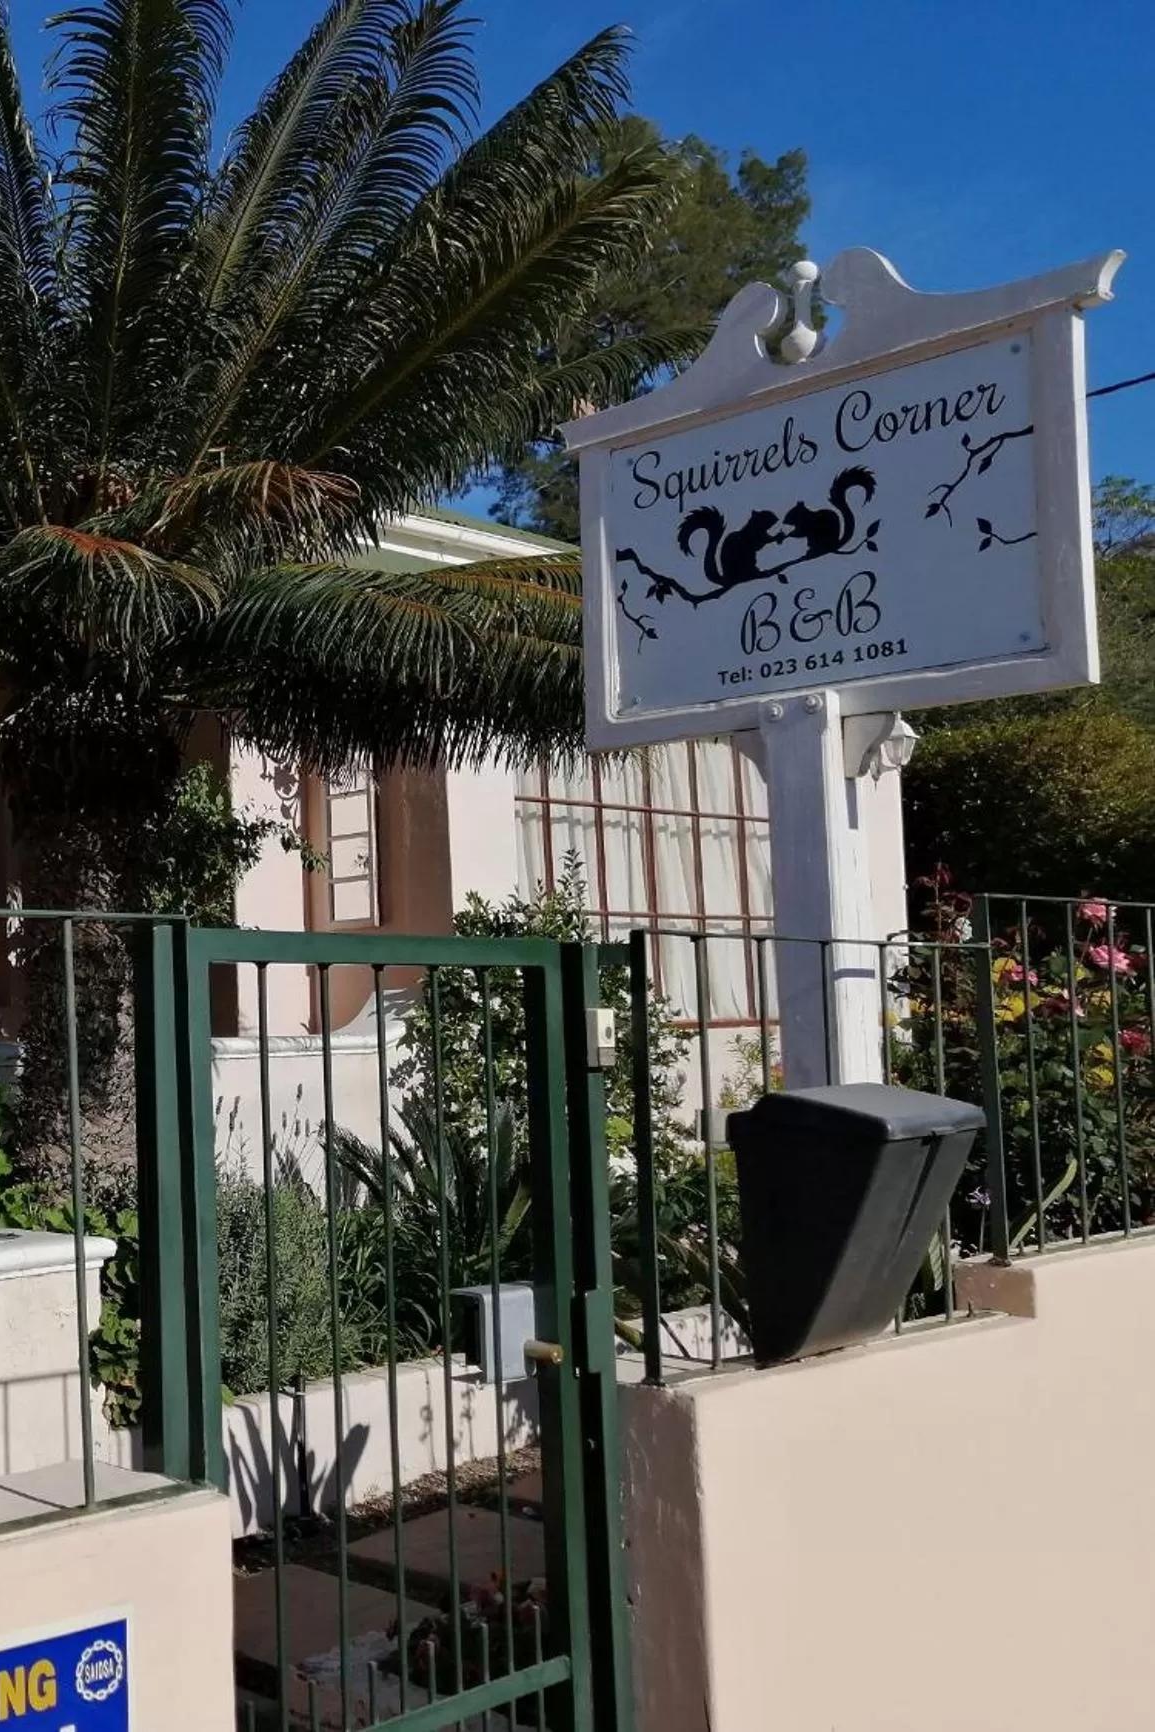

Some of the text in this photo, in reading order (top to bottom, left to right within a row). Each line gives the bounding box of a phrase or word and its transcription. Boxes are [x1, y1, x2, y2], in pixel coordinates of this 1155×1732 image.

[632, 381, 1005, 511] Squirrels Corner
[740, 570, 882, 655] B&B
[718, 638, 908, 686] Tel: 023 614 1081
